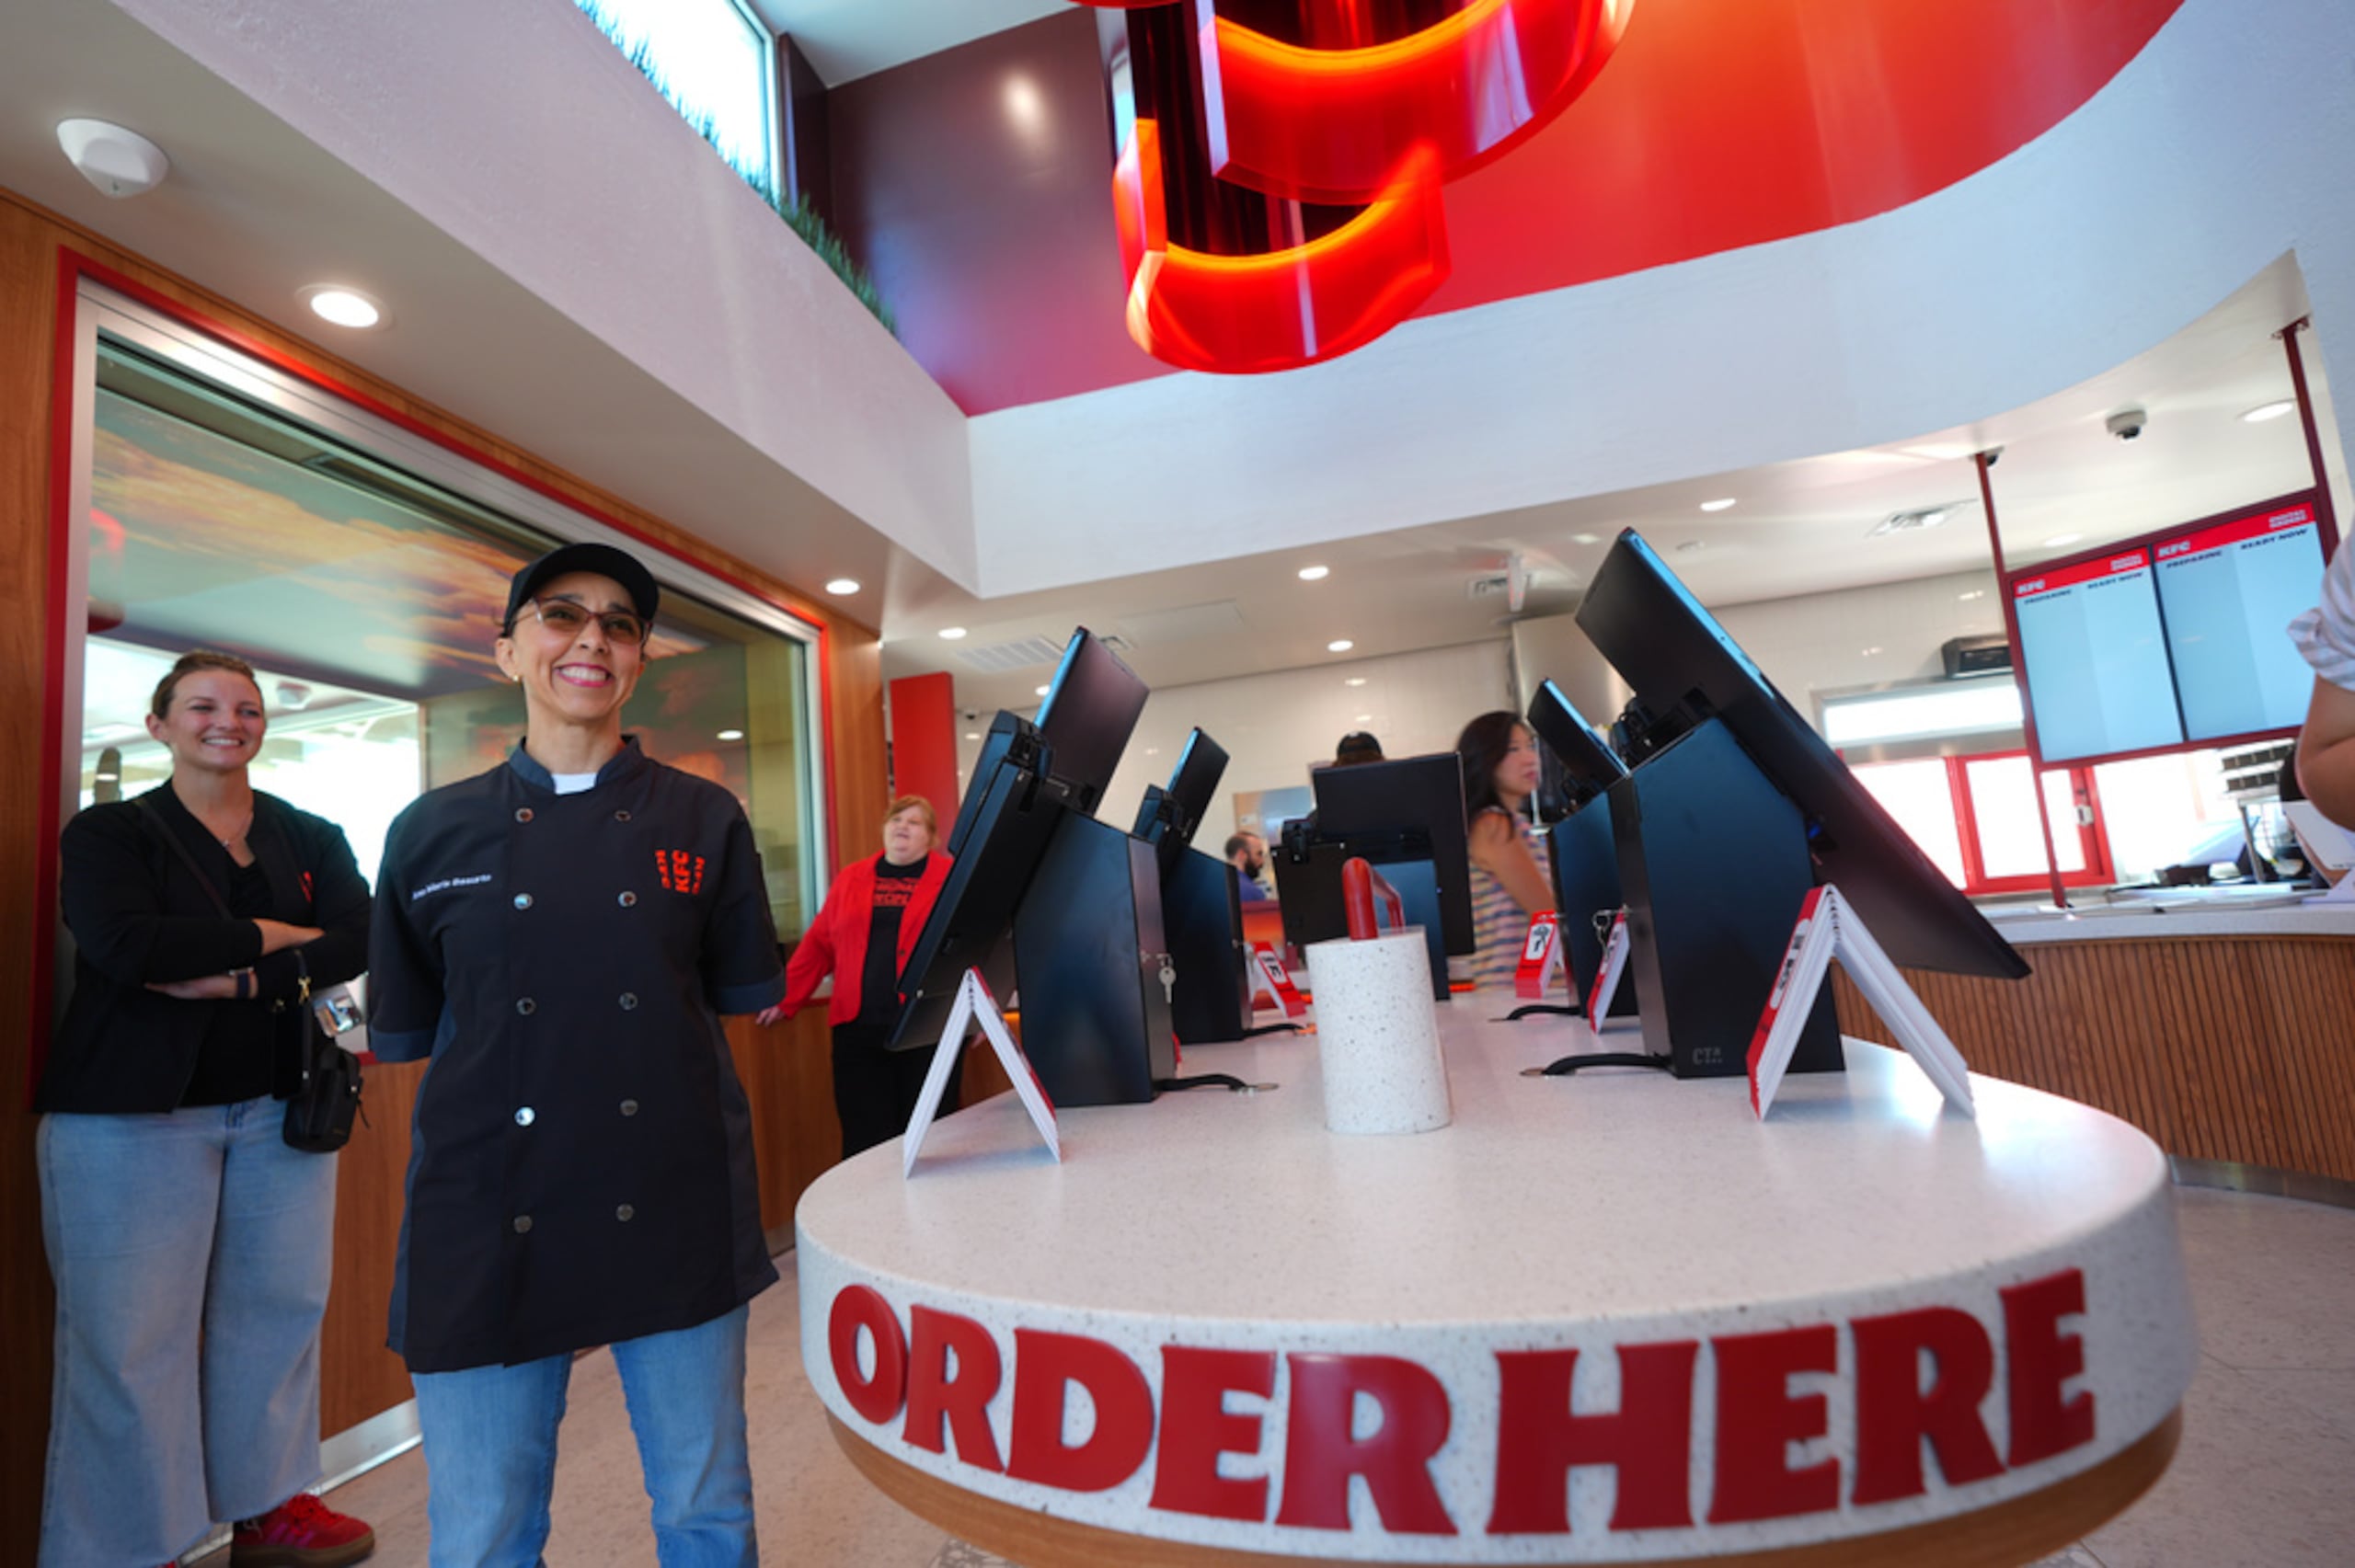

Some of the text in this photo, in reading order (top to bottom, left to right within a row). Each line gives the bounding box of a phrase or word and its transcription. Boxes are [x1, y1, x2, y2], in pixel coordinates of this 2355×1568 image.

[2158, 541, 2190, 557] KFC
[2240, 529, 2308, 550] READY NOW
[2016, 578, 2045, 594] KFC
[671, 850, 691, 894] KFC
[828, 1267, 2096, 1536] ORDER HERE
